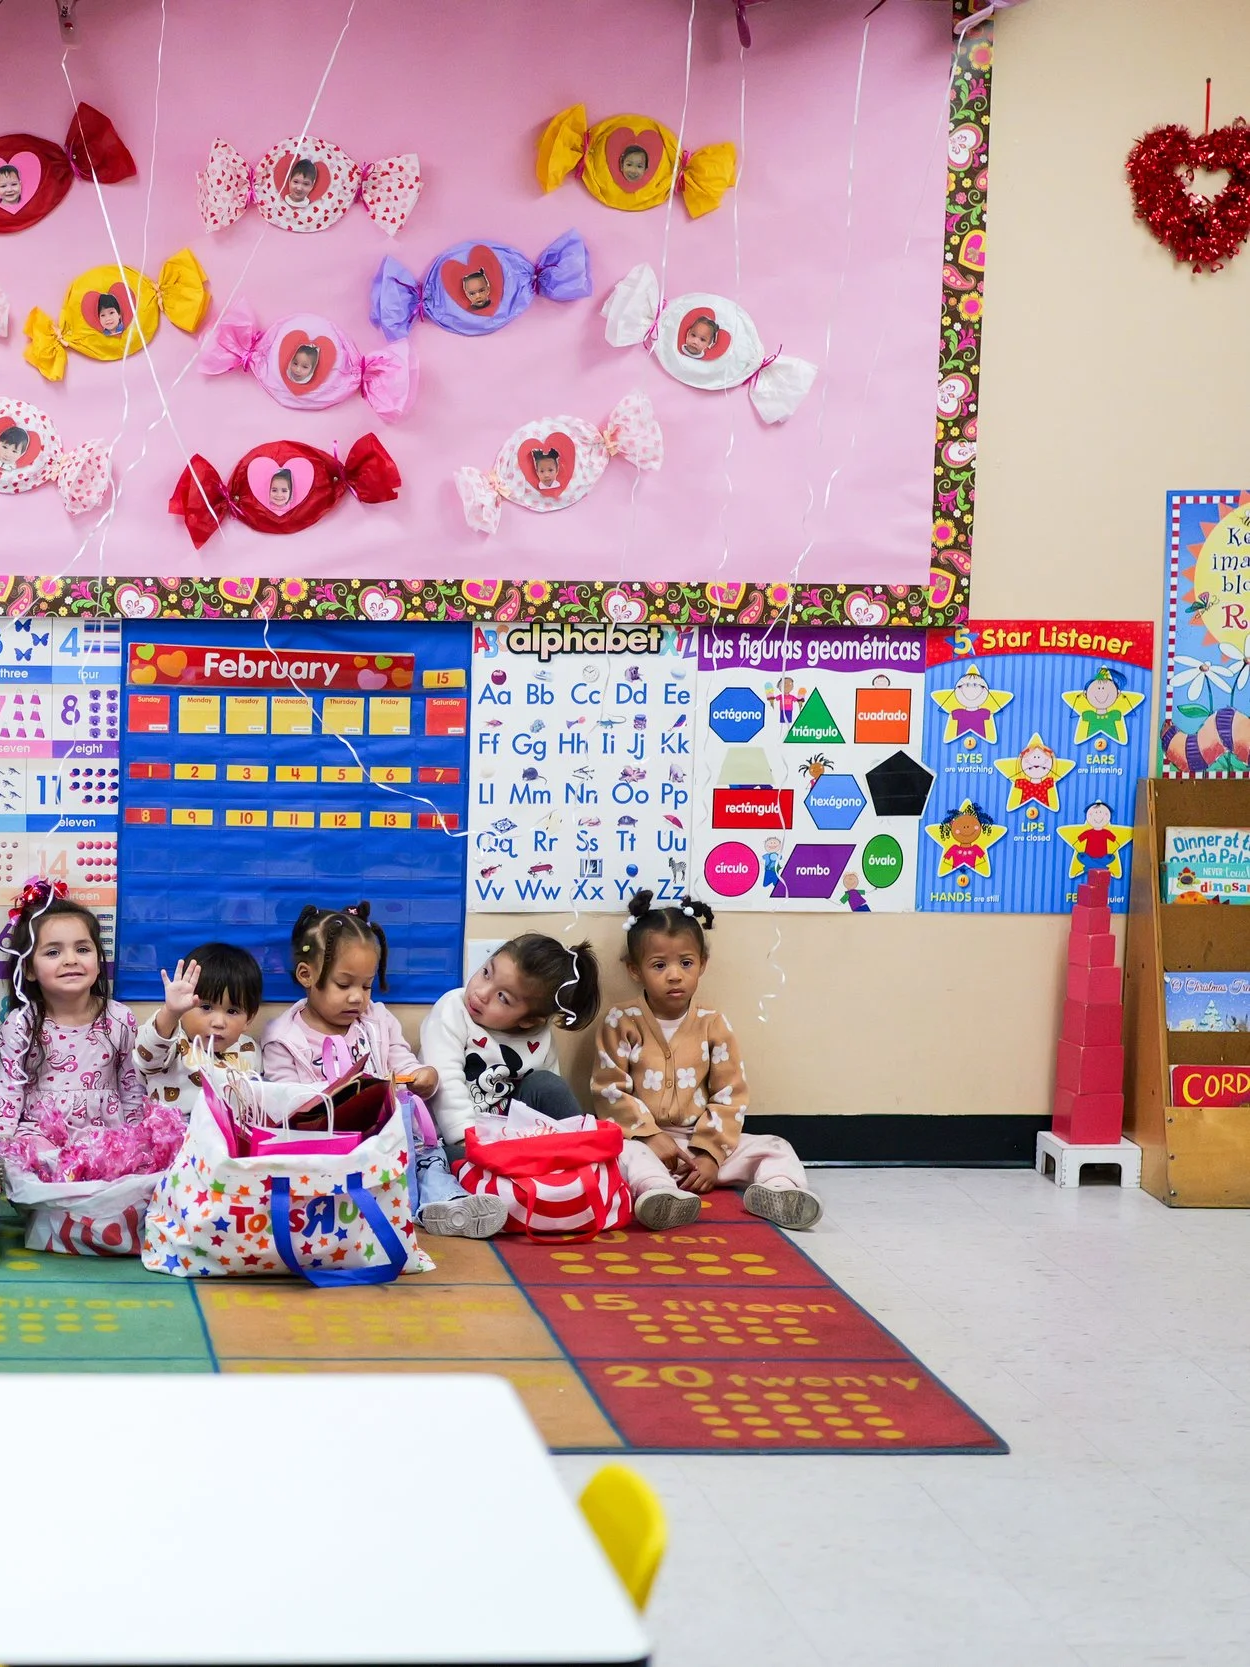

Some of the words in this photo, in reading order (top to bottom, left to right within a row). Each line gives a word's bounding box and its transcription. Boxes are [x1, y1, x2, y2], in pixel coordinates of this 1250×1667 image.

[1222, 603, 1248, 630] R
[59, 627, 80, 657] 4
[507, 623, 662, 662] alphabet
[703, 634, 734, 660] Las
[738, 632, 802, 666] figuras
[807, 633, 921, 666] geométricas
[953, 627, 971, 655] 5
[982, 628, 1032, 649] Star
[1039, 627, 1134, 656] Listener
[0, 668, 29, 678] three
[78, 668, 100, 680] four
[204, 652, 341, 686] February
[436, 672, 449, 685] 15
[137, 696, 161, 704] Sunday
[274, 698, 309, 706] Wednesday
[478, 684, 511, 705] Aa
[526, 684, 554, 705] Bb
[570, 684, 601, 705] Cc
[616, 684, 647, 705] Dd
[664, 684, 690, 705] Ee
[61, 695, 80, 725] 8
[432, 699, 460, 707] Saturday
[713, 707, 762, 723] octágono
[857, 710, 908, 722] cuadrado
[792, 725, 839, 739] triángulo
[75, 743, 103, 755] eight
[479, 733, 500, 754] Ff
[512, 733, 547, 761] Gg
[559, 733, 588, 754] Hh
[602, 733, 615, 754] Ii
[626, 733, 644, 760] Jj
[661, 733, 689, 754] Kk
[956, 754, 983, 763] EYES
[1086, 754, 1115, 765] EARS
[191, 766, 199, 778] 2
[243, 768, 251, 780] 3
[291, 767, 300, 780] 4
[337, 769, 346, 781] 5
[386, 768, 394, 781] 6
[434, 769, 444, 781] 7
[958, 765, 993, 775] watching
[1090, 766, 1123, 776] listening
[509, 783, 551, 804] Mm
[565, 783, 598, 804] Nn
[612, 783, 649, 805] Oo
[661, 783, 689, 810] Pp
[725, 803, 780, 816] rectángulo
[810, 796, 862, 808] hexágono
[59, 817, 96, 827] eleven
[141, 809, 150, 822] 8
[188, 812, 196, 824] 9
[239, 812, 253, 824] 10
[290, 813, 298, 825] 11
[334, 814, 347, 826] 12
[384, 814, 396, 826] 13
[1021, 822, 1045, 832] LIPS
[534, 831, 558, 851] Rr
[576, 831, 599, 851] Ss
[616, 831, 636, 851] Tt
[657, 831, 687, 852] Uu
[1027, 833, 1051, 842] closed
[1173, 835, 1222, 853] Dinner
[1224, 832, 1239, 848] at
[38, 850, 69, 879] 14
[868, 855, 897, 866] óvalo
[715, 863, 749, 874] círculo
[796, 864, 830, 876] rombo
[1203, 867, 1223, 876] NEVER
[475, 879, 505, 900] Vv
[515, 879, 561, 900] Ww
[573, 879, 604, 900] Xx
[656, 879, 685, 900] Zz
[1201, 881, 1250, 893] dinosa
[930, 892, 972, 902] HANDS
[974, 895, 985, 903] are
[986, 894, 1000, 903] still
[1185, 977, 1227, 994] Christmas
[1182, 1073, 1250, 1105] CORD
[649, 1233, 727, 1244] ten
[560, 1293, 638, 1311] 15
[661, 1300, 837, 1315] fifteen
[603, 1366, 714, 1388] 20
[727, 1373, 921, 1391] twenty
